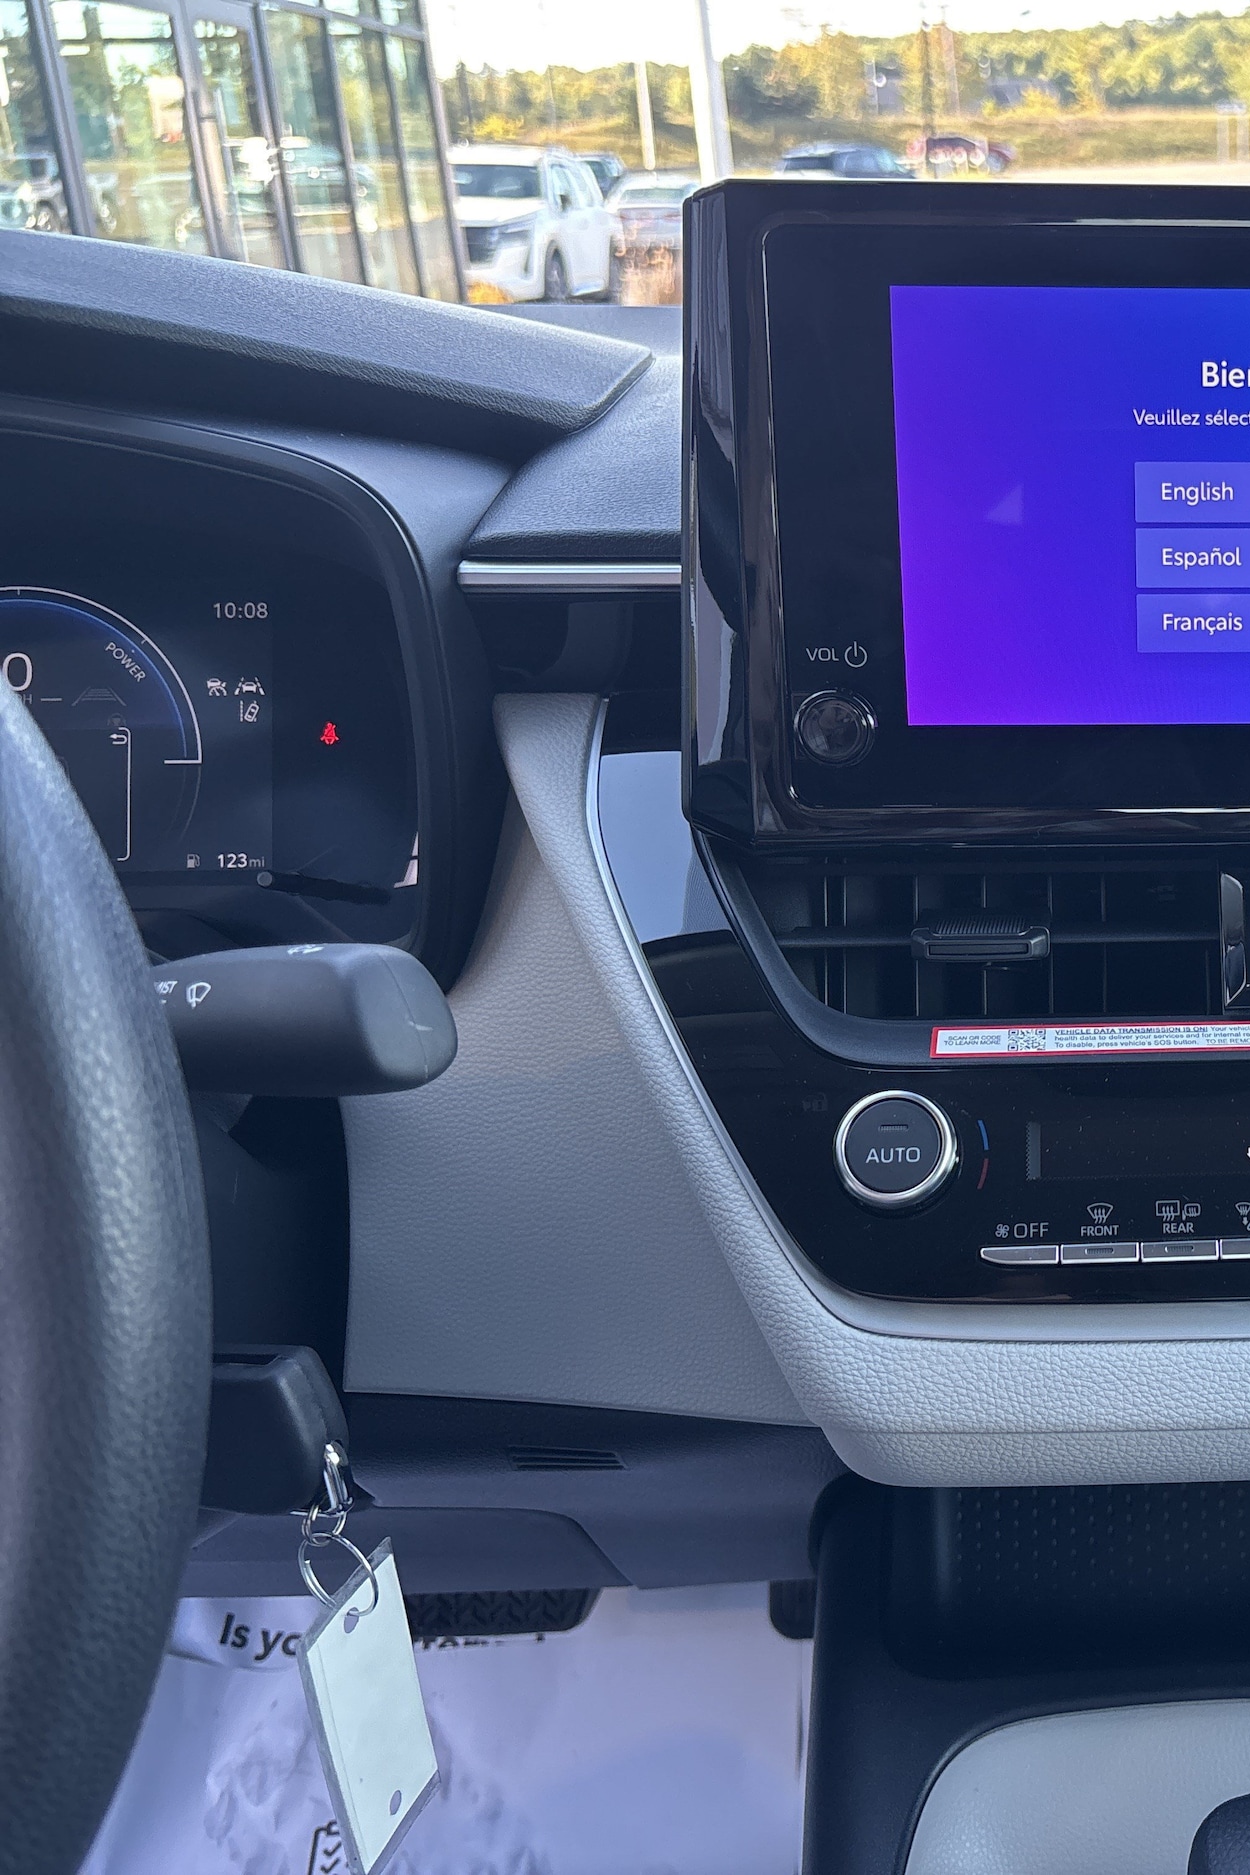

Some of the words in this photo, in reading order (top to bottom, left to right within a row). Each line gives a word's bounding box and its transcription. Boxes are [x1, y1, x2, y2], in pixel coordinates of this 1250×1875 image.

[1133, 409, 1200, 426] Veuillez
[1161, 482, 1234, 506] English
[1162, 547, 1242, 569] Español
[213, 602, 268, 619] 10:08
[1163, 612, 1243, 635] Français
[104, 641, 146, 682] POWER
[805, 647, 839, 661] VOL
[217, 853, 248, 868] 123
[249, 856, 265, 868] mi
[866, 1147, 921, 1163] AUTO
[1014, 1222, 1049, 1238] OFF
[1081, 1224, 1119, 1236] FRONT
[1163, 1222, 1194, 1234] REAR
[219, 1612, 249, 1649] Is
[255, 1629, 301, 1661] yo
